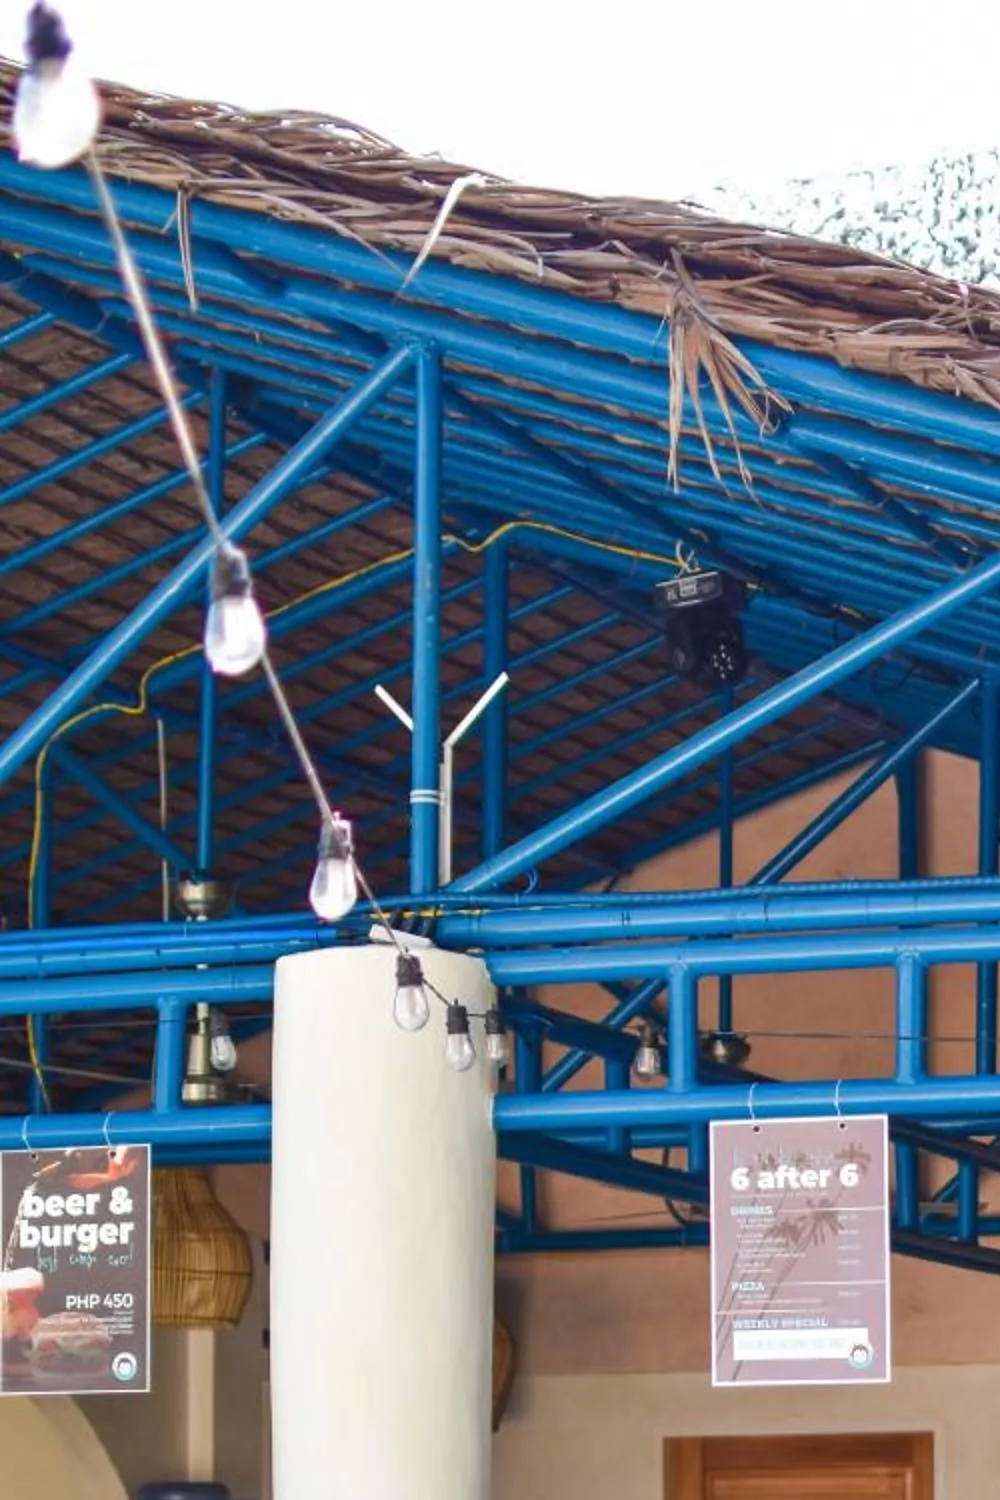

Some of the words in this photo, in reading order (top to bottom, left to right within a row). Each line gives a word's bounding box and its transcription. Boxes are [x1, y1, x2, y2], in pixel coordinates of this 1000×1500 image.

[730, 1167, 749, 1190] 6
[757, 1165, 831, 1189] after
[840, 1163, 859, 1187] 6
[23, 1187, 100, 1218] beer
[109, 1186, 133, 1215] &
[19, 1219, 134, 1253] burger
[65, 1294, 100, 1309] PHP
[103, 1293, 133, 1309] 450
